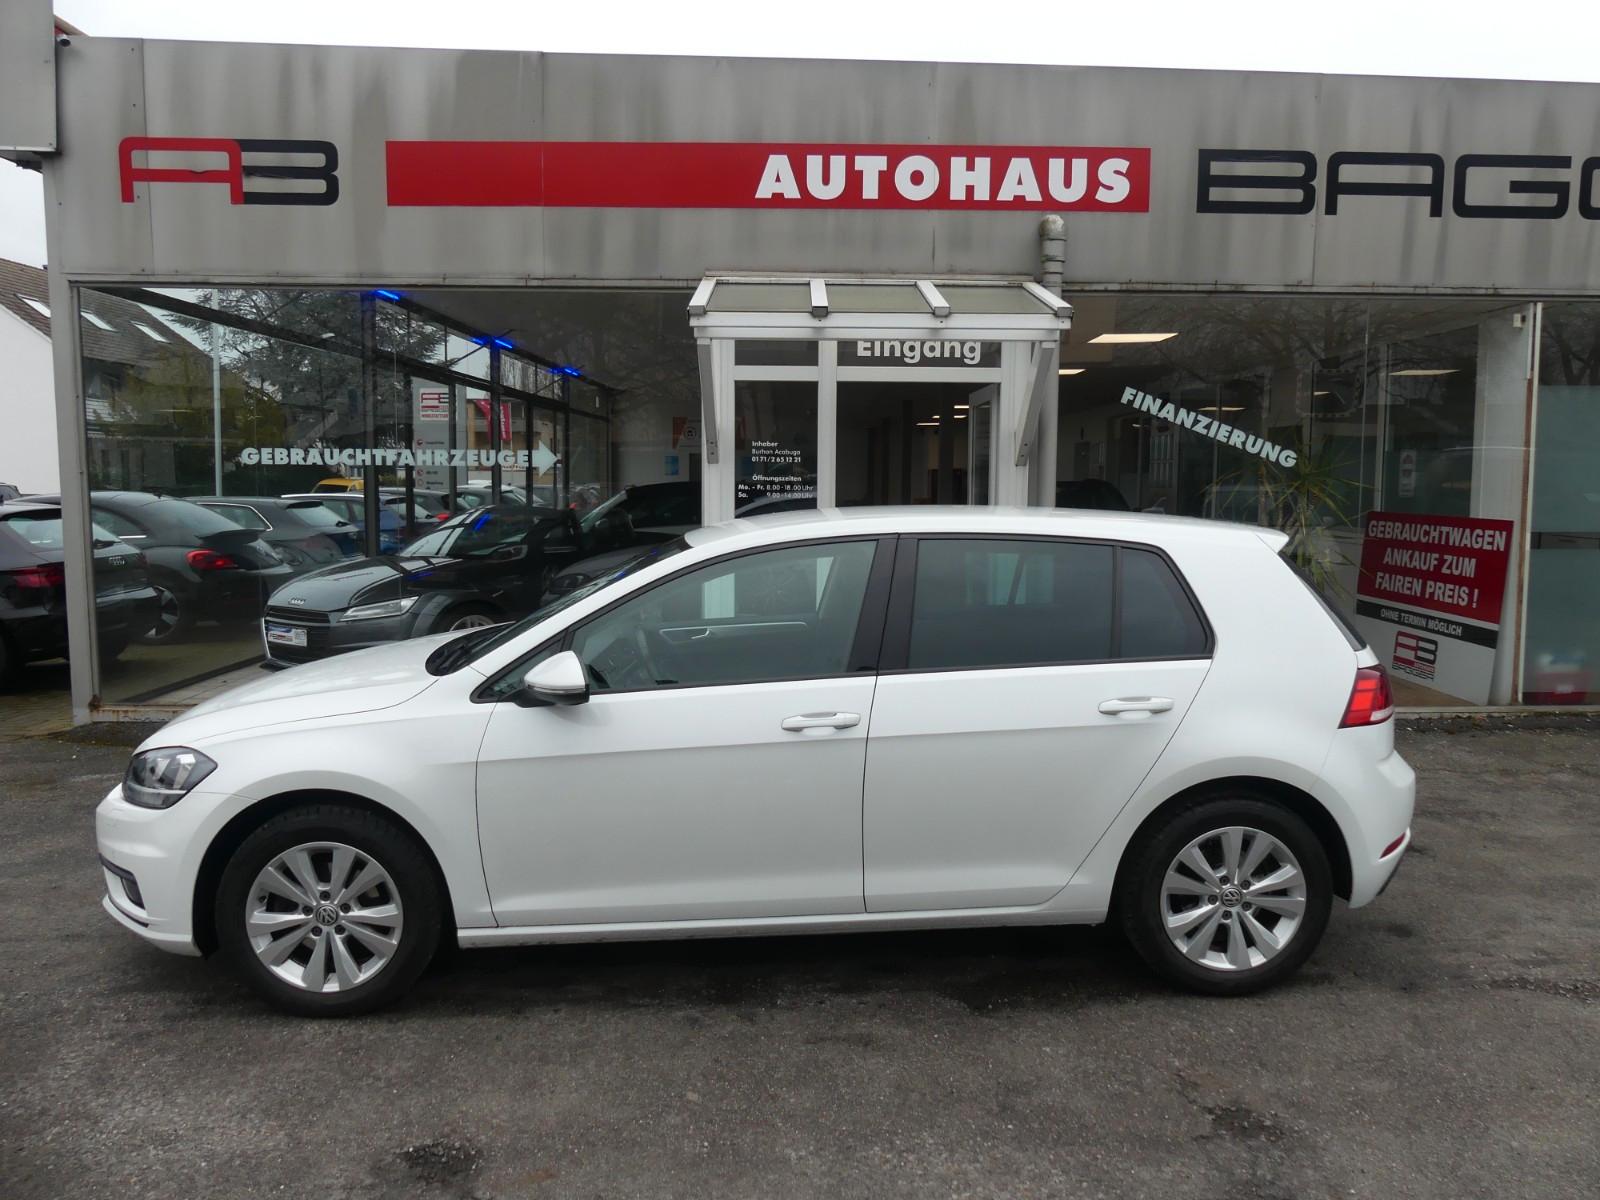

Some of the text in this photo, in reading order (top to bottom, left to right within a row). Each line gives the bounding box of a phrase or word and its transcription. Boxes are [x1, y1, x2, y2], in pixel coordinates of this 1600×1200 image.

[754, 149, 1600, 220] AUTOHAUS BAG
[857, 340, 981, 364] Eingang
[1120, 386, 1297, 468] FINANZIERUNG
[240, 446, 529, 468] GEBRAUCHTFAHRZEUGE
[752, 474, 802, 482] Öffnungszeiten
[1368, 520, 1506, 552] GEBRAUCHTWAGEN
[1383, 547, 1477, 578] ANKAUF ZUM
[1375, 572, 1422, 597] FAIREN
[1425, 580, 1469, 607] PREIS
[1380, 608, 1463, 636] OHNE TERMIN MÖGLICH
